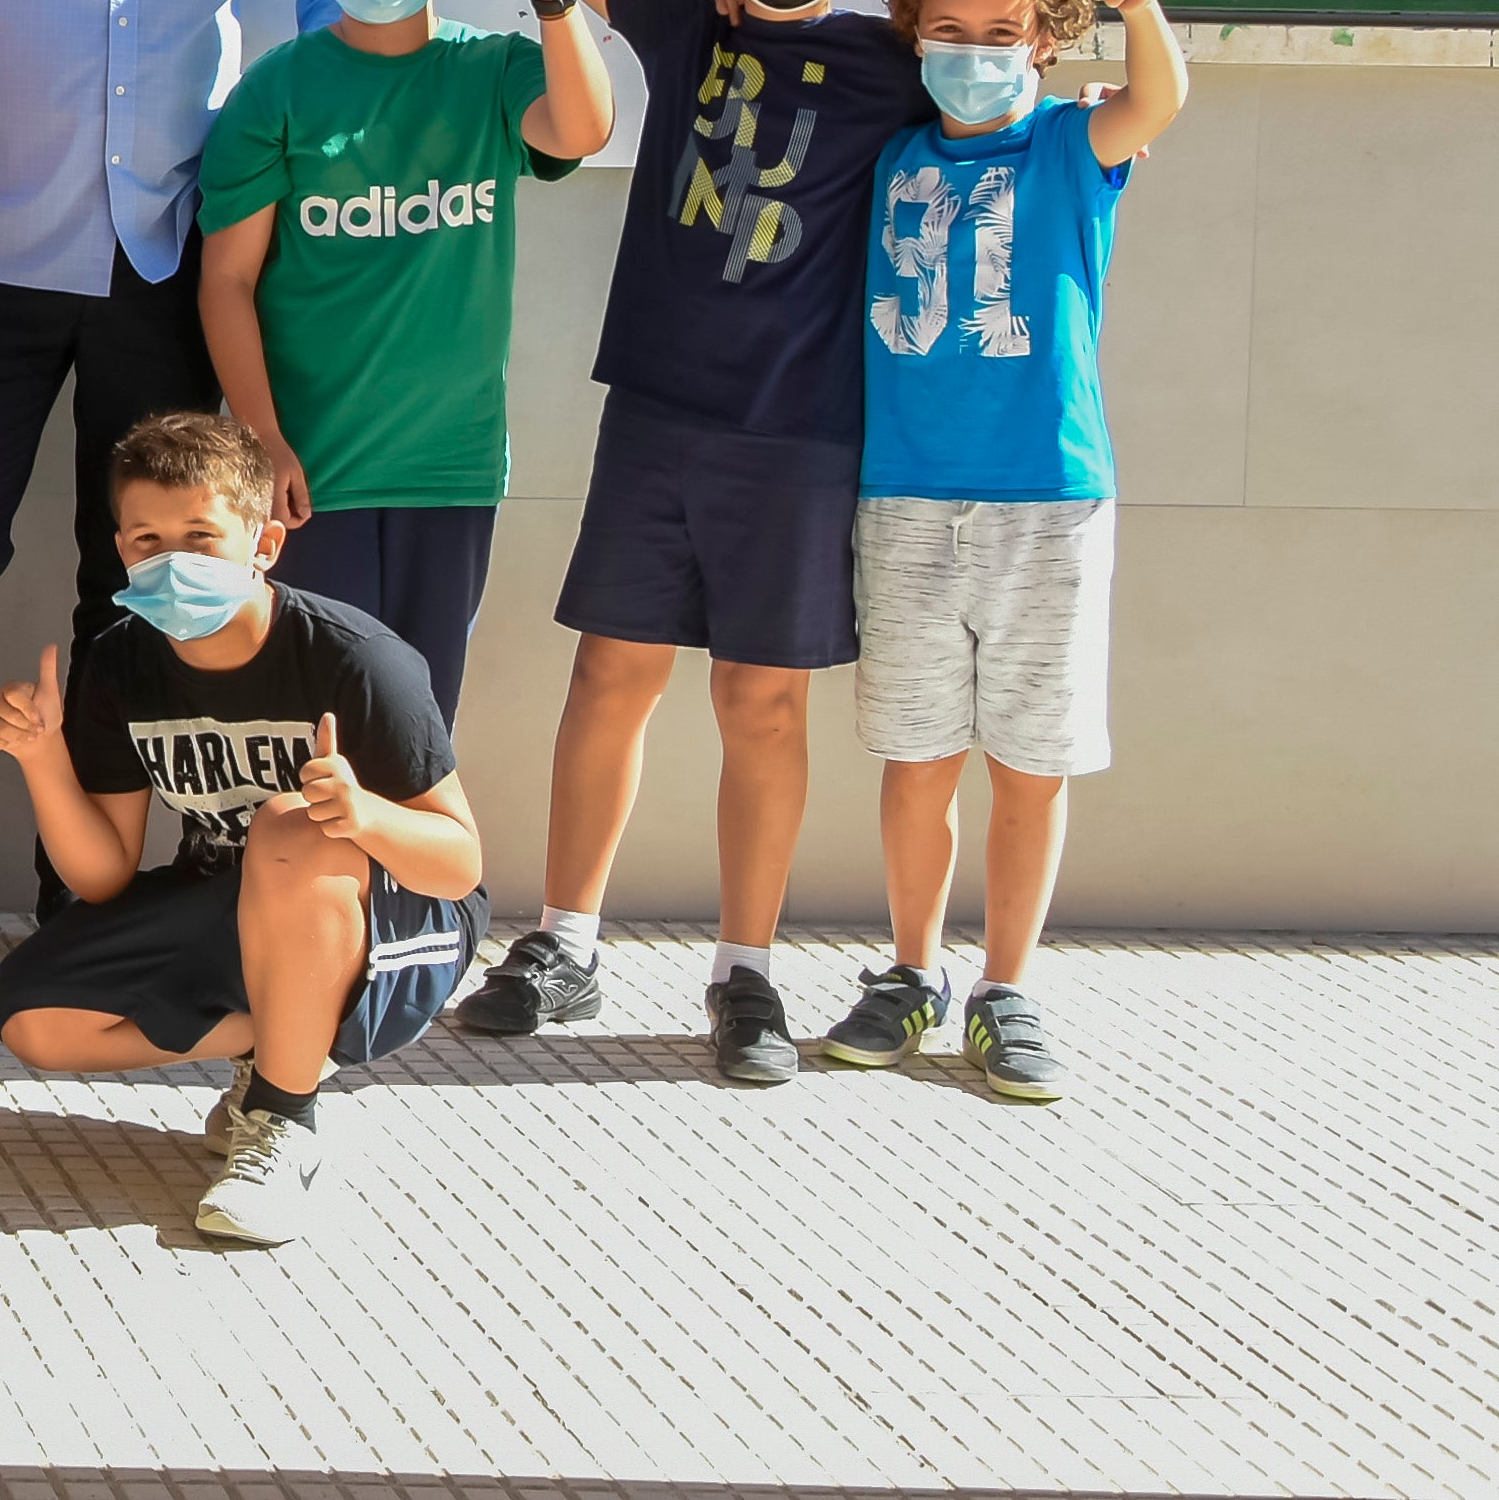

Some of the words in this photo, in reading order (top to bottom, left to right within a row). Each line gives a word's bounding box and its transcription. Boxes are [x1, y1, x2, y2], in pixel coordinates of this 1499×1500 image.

[300, 179, 496, 238] adidas
[870, 166, 1031, 357] 91
[136, 731, 314, 796] HARLEM
